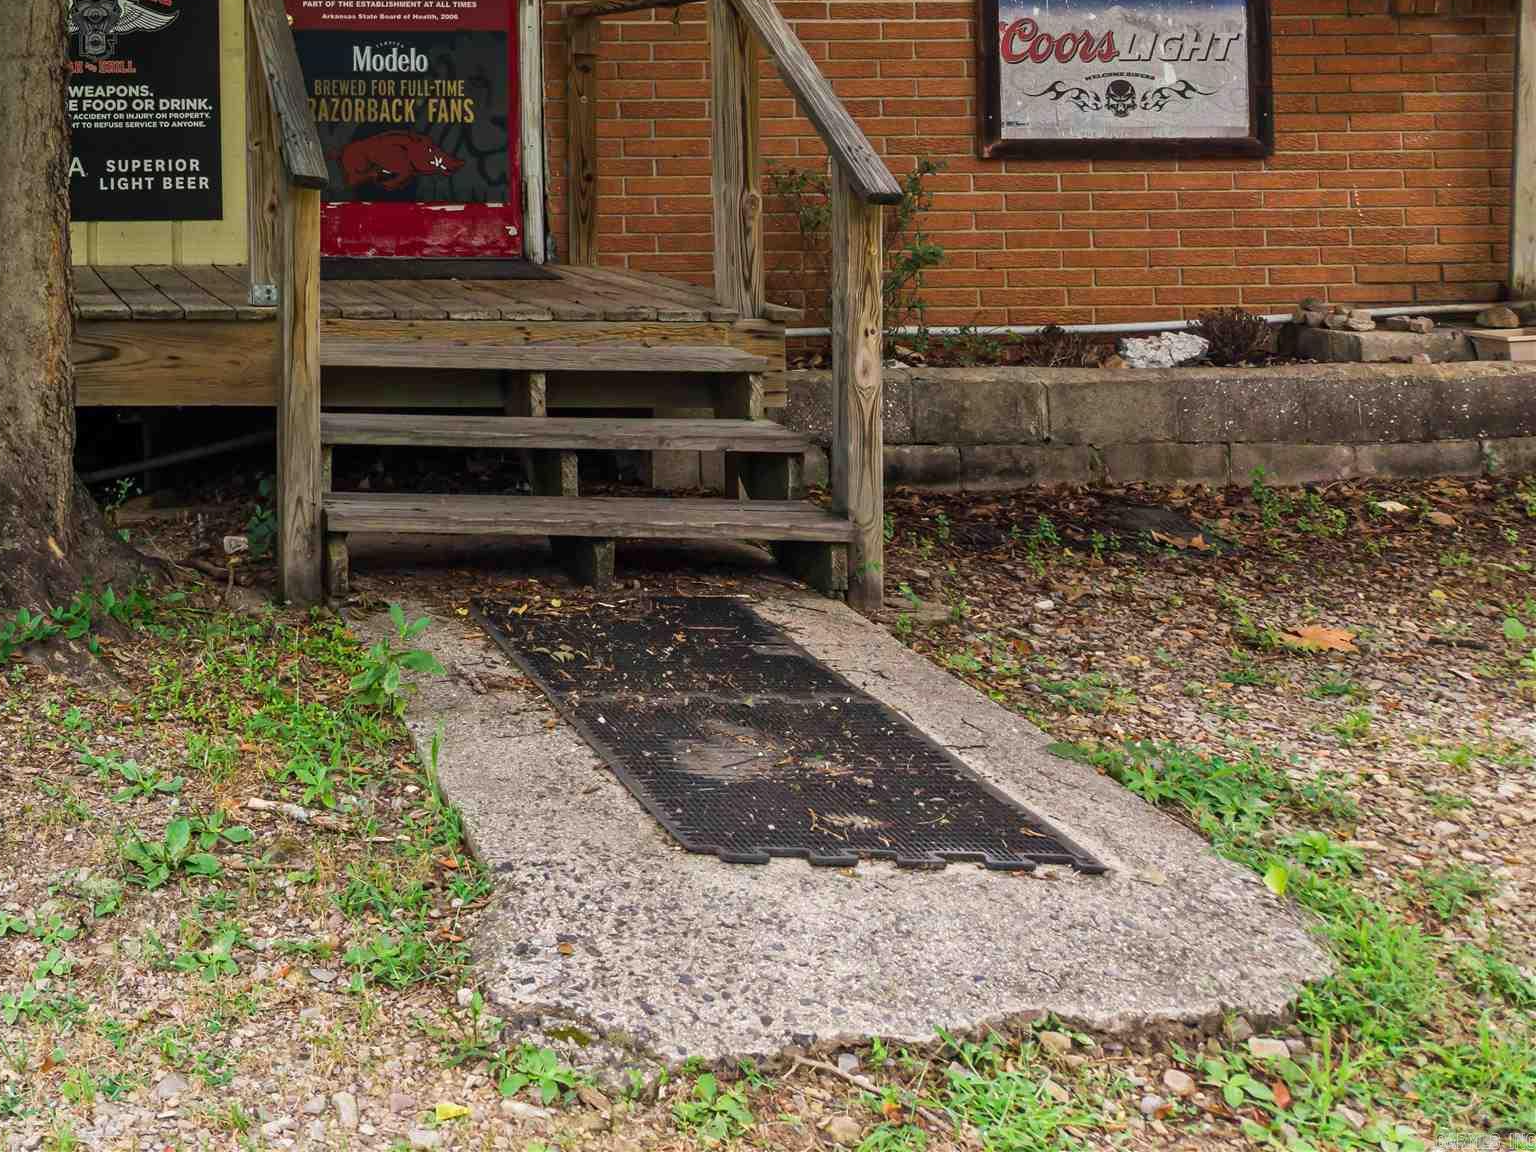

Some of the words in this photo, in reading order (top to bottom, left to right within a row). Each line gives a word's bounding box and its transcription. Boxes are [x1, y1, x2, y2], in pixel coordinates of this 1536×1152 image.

[1000, 17, 1119, 64] Coors
[1119, 32, 1240, 62] LIGHT
[353, 46, 428, 72] Modelo
[68, 85, 154, 97] WEAPONS.
[314, 80, 366, 96] BREWED
[372, 80, 395, 96] FOR
[400, 80, 464, 96] FULL-TIME
[83, 100, 127, 111] FOOD
[132, 99, 155, 111] OR
[159, 99, 212, 110] DRINK.
[428, 99, 474, 123] FANS
[106, 159, 200, 173] SUPERIOR
[99, 177, 154, 190] LIGHT
[163, 177, 209, 190] BEER
